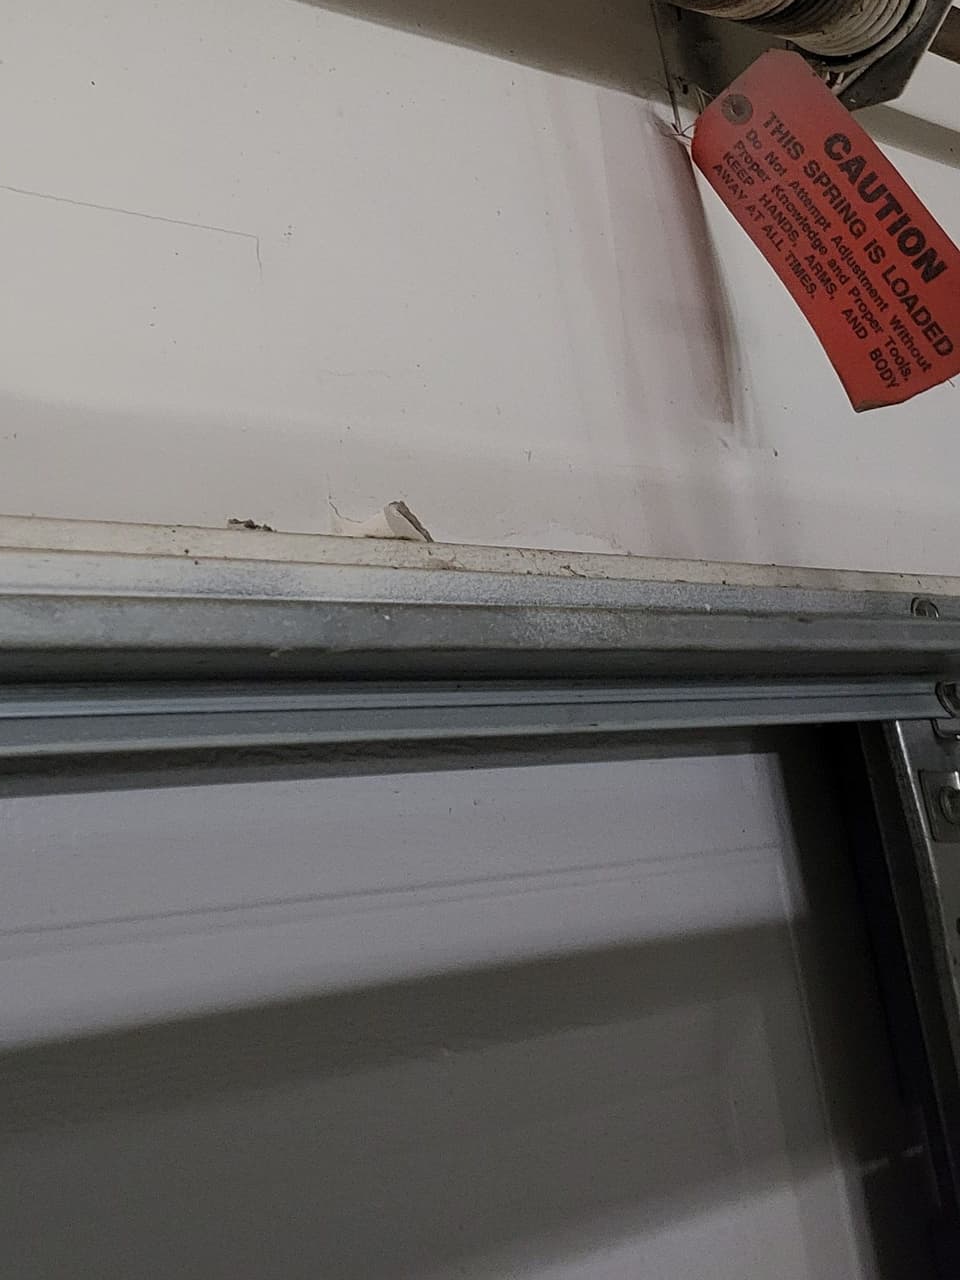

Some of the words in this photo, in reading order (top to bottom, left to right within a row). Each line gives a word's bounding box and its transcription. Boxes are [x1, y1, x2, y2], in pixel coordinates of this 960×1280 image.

[712, 164, 748, 200] AWAY
[745, 204, 765, 221] AT
[762, 225, 784, 252] ALL
[785, 250, 817, 299] TIMES.
[722, 151, 755, 186] KEEP
[759, 194, 799, 247] HANDS,
[804, 255, 837, 300] ARMS,
[841, 308, 868, 339] AND
[870, 348, 899, 388] BODY
[734, 140, 771, 182] Proper
[771, 184, 828, 255] Knowledge
[828, 259, 850, 285] and
[848, 286, 884, 333] Proper
[885, 336, 911, 381] Tools.
[746, 128, 762, 149] Do
[765, 152, 787, 176] Not
[789, 181, 831, 232] Attempt
[831, 236, 889, 312] Adjustment
[889, 315, 932, 372] Without
[763, 111, 804, 160] THIS
[803, 160, 866, 239] SPRING
[864, 238, 886, 264] IS
[882, 265, 953, 356] LOADED
[824, 133, 948, 283] CAUTION
